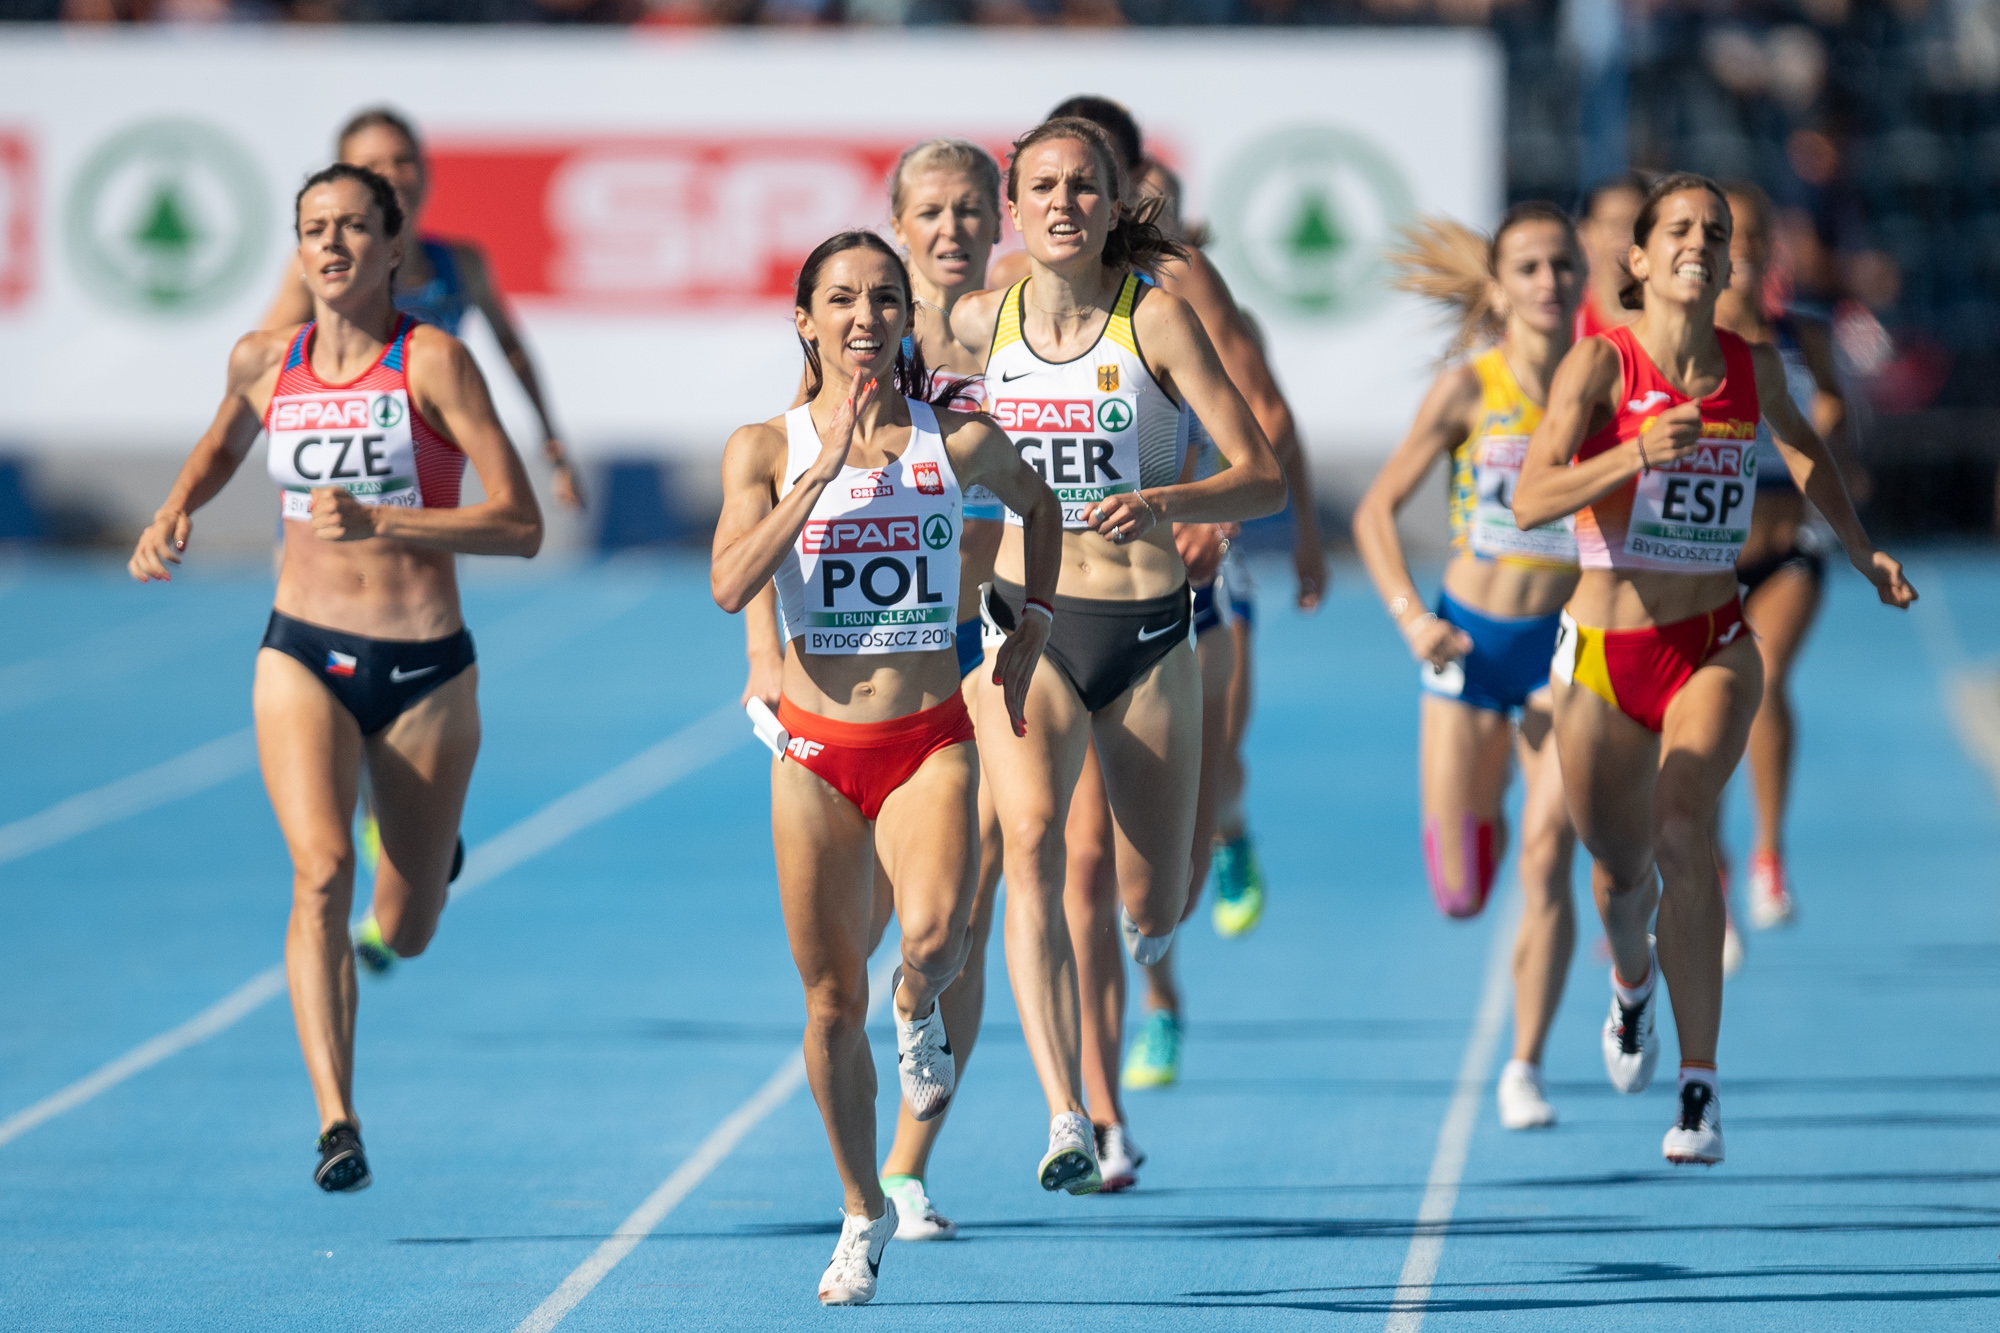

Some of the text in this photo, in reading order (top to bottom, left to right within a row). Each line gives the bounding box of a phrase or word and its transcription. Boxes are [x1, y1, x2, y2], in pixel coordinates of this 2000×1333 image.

[277, 401, 368, 428] SPAR
[995, 402, 1093, 429] SPAR
[293, 434, 393, 480] CZE
[1014, 437, 1123, 484] GER
[1659, 447, 1739, 474] PAR
[852, 487, 892, 499] ORLEN
[1662, 477, 1744, 525] ESP
[804, 521, 916, 550] SPAR
[1667, 526, 1694, 539] RUN
[1632, 538, 1721, 561] BYDGOSZCZ
[822, 556, 943, 607] POL
[835, 614, 839, 625] I
[843, 612, 874, 625] RUN
[812, 629, 949, 649] BYDGOSZCZ 201
[787, 736, 825, 760] 4F
